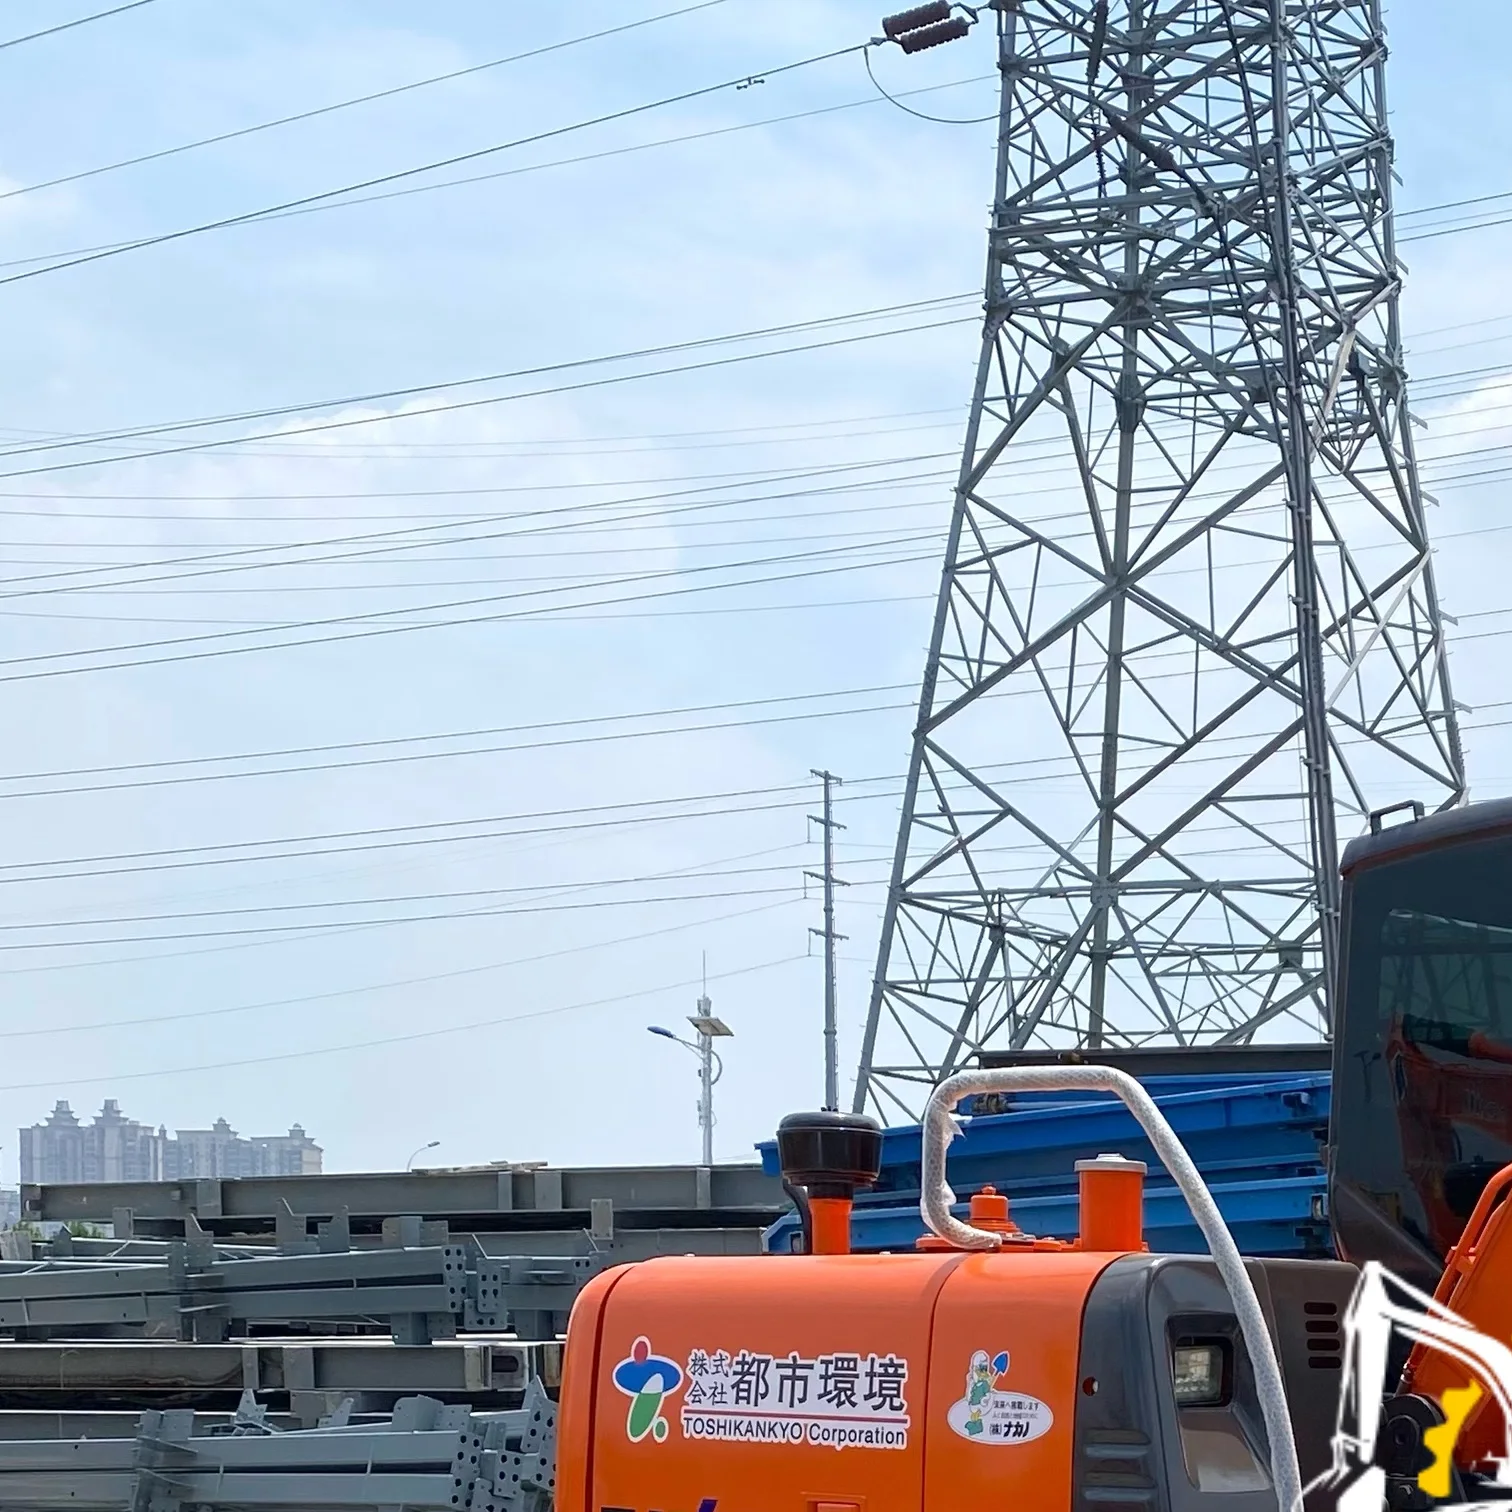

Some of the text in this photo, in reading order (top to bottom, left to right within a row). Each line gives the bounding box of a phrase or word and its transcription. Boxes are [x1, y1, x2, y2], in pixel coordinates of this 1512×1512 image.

[731, 1353, 906, 1411] 都市環境
[683, 1416, 905, 1446] TOSHIKANKYO Corporation
